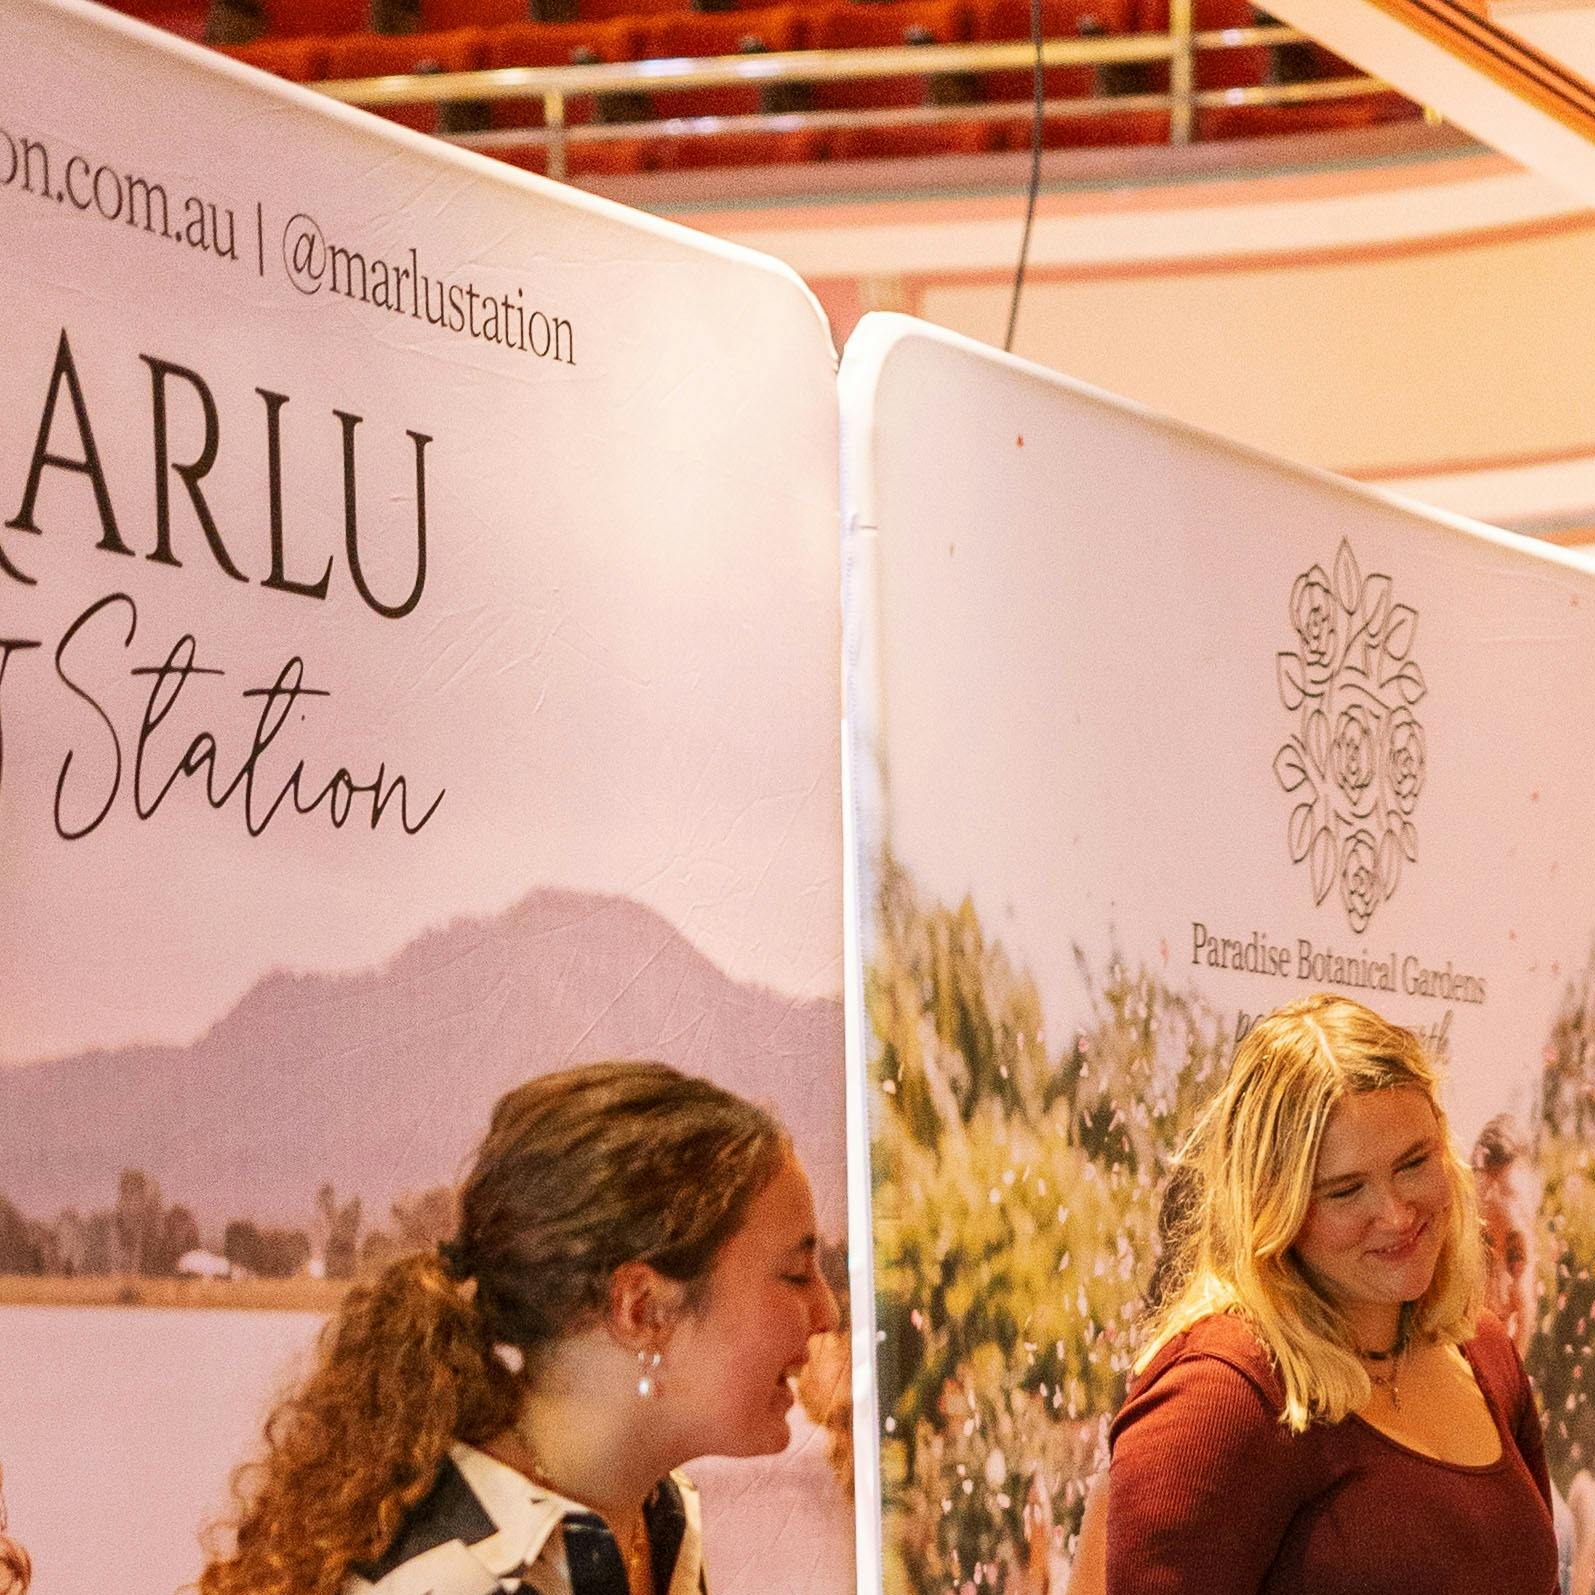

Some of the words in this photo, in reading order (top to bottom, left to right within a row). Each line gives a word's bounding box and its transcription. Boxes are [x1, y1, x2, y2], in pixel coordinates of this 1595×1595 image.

[282, 212, 577, 366] @marlustation
[5, 326, 434, 620] ARLU
[54, 592, 447, 841] Station
[1191, 922, 1292, 978] Paradise
[1296, 938, 1397, 993] Botanical
[1401, 955, 1488, 1005] Gardens
